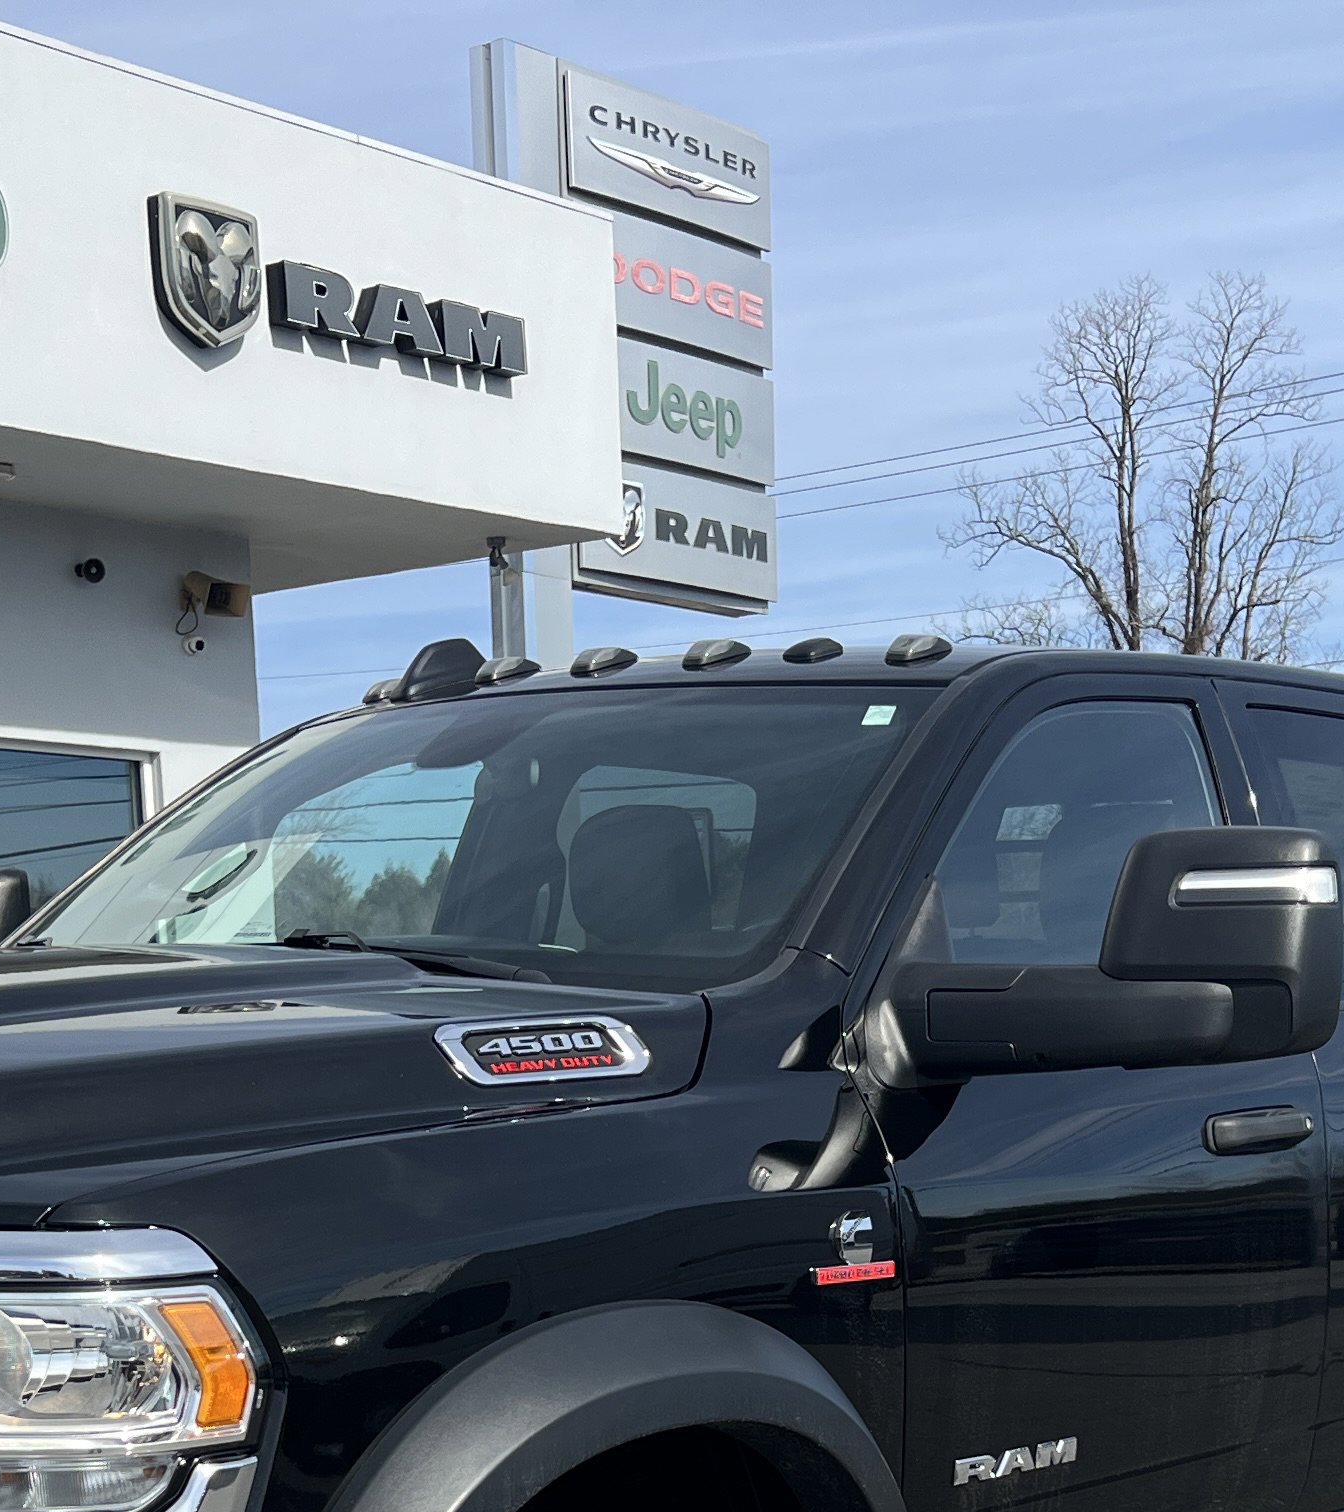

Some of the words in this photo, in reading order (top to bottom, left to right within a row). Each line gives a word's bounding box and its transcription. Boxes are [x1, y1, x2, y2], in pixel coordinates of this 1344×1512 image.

[588, 104, 757, 180] CHRYSLER
[265, 260, 528, 378] RAM
[626, 360, 742, 458] Jeep
[654, 507, 768, 563] RAM
[477, 1031, 603, 1058] 4500
[490, 1059, 557, 1075] HEAVY
[559, 1054, 613, 1069] DUTY
[953, 1435, 1078, 1487] RAM
